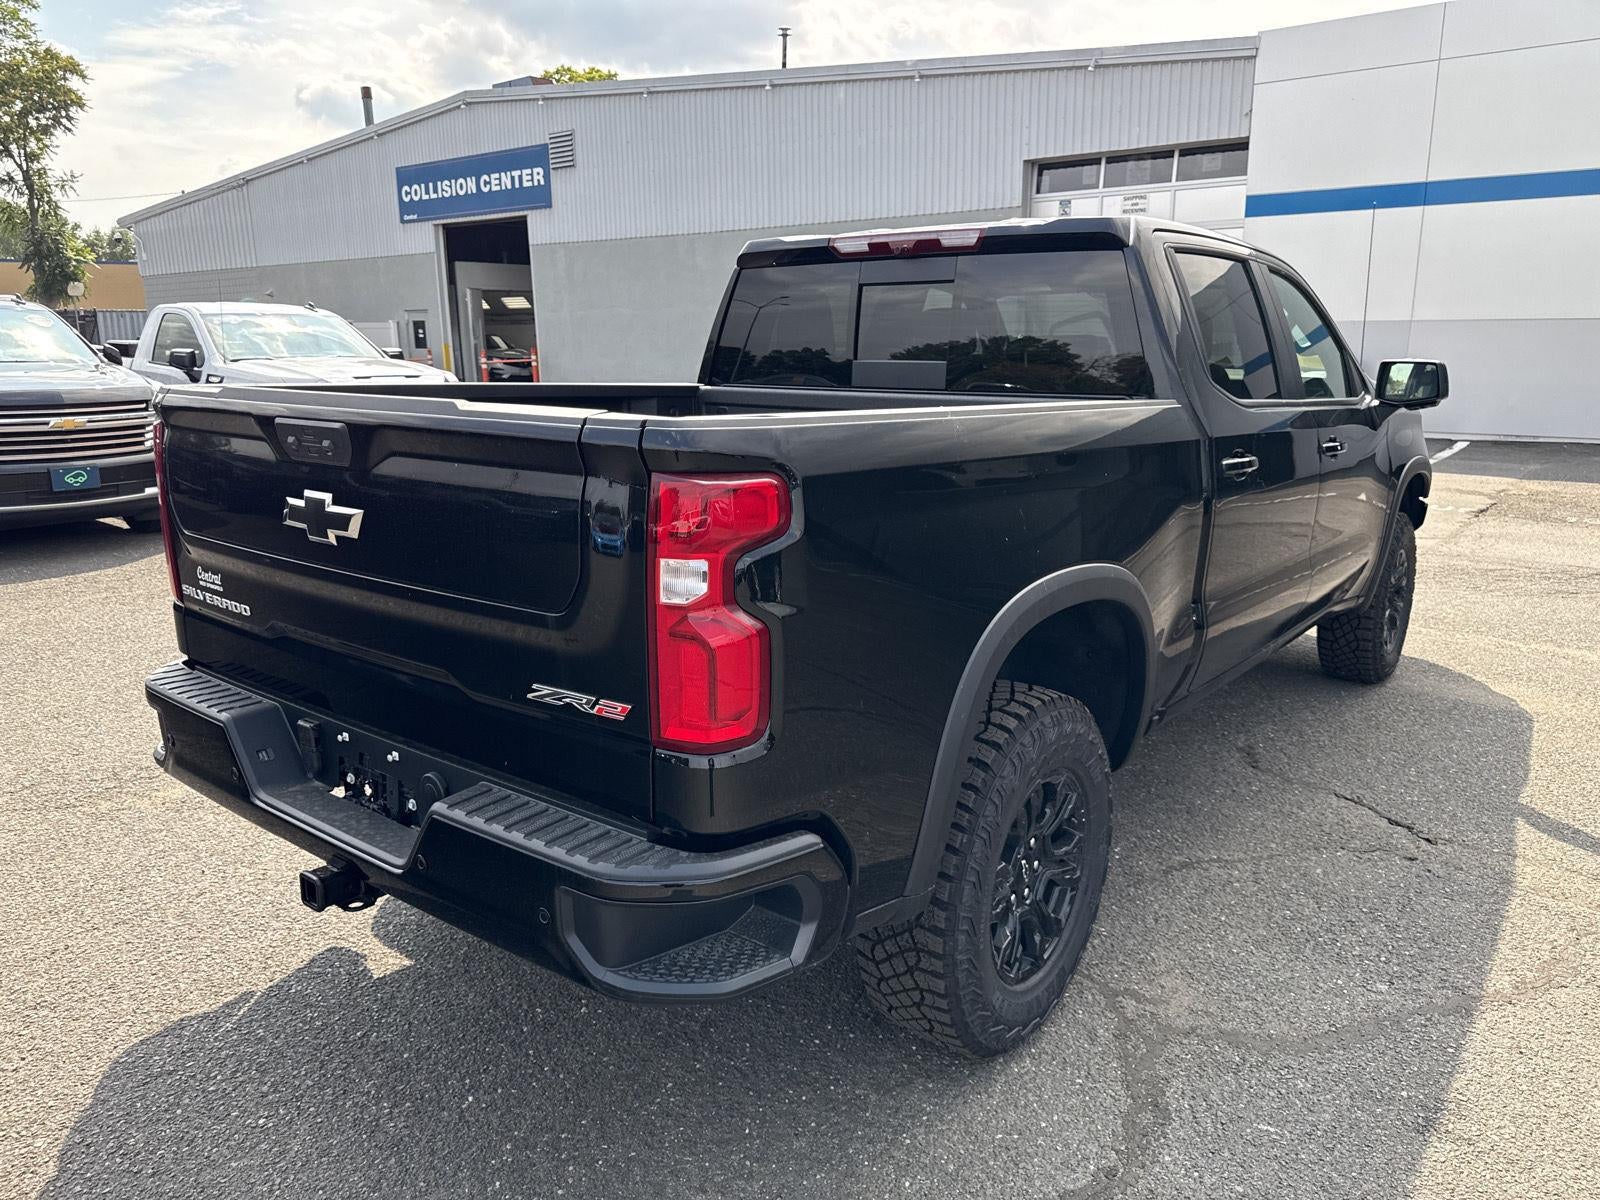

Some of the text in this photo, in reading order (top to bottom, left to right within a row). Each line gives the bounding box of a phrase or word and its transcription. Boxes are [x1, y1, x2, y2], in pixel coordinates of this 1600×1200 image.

[401, 167, 545, 202] COLLISION CENTER
[197, 565, 222, 585] Central
[181, 584, 251, 617] SILVERADO
[526, 683, 632, 721] ZR2
